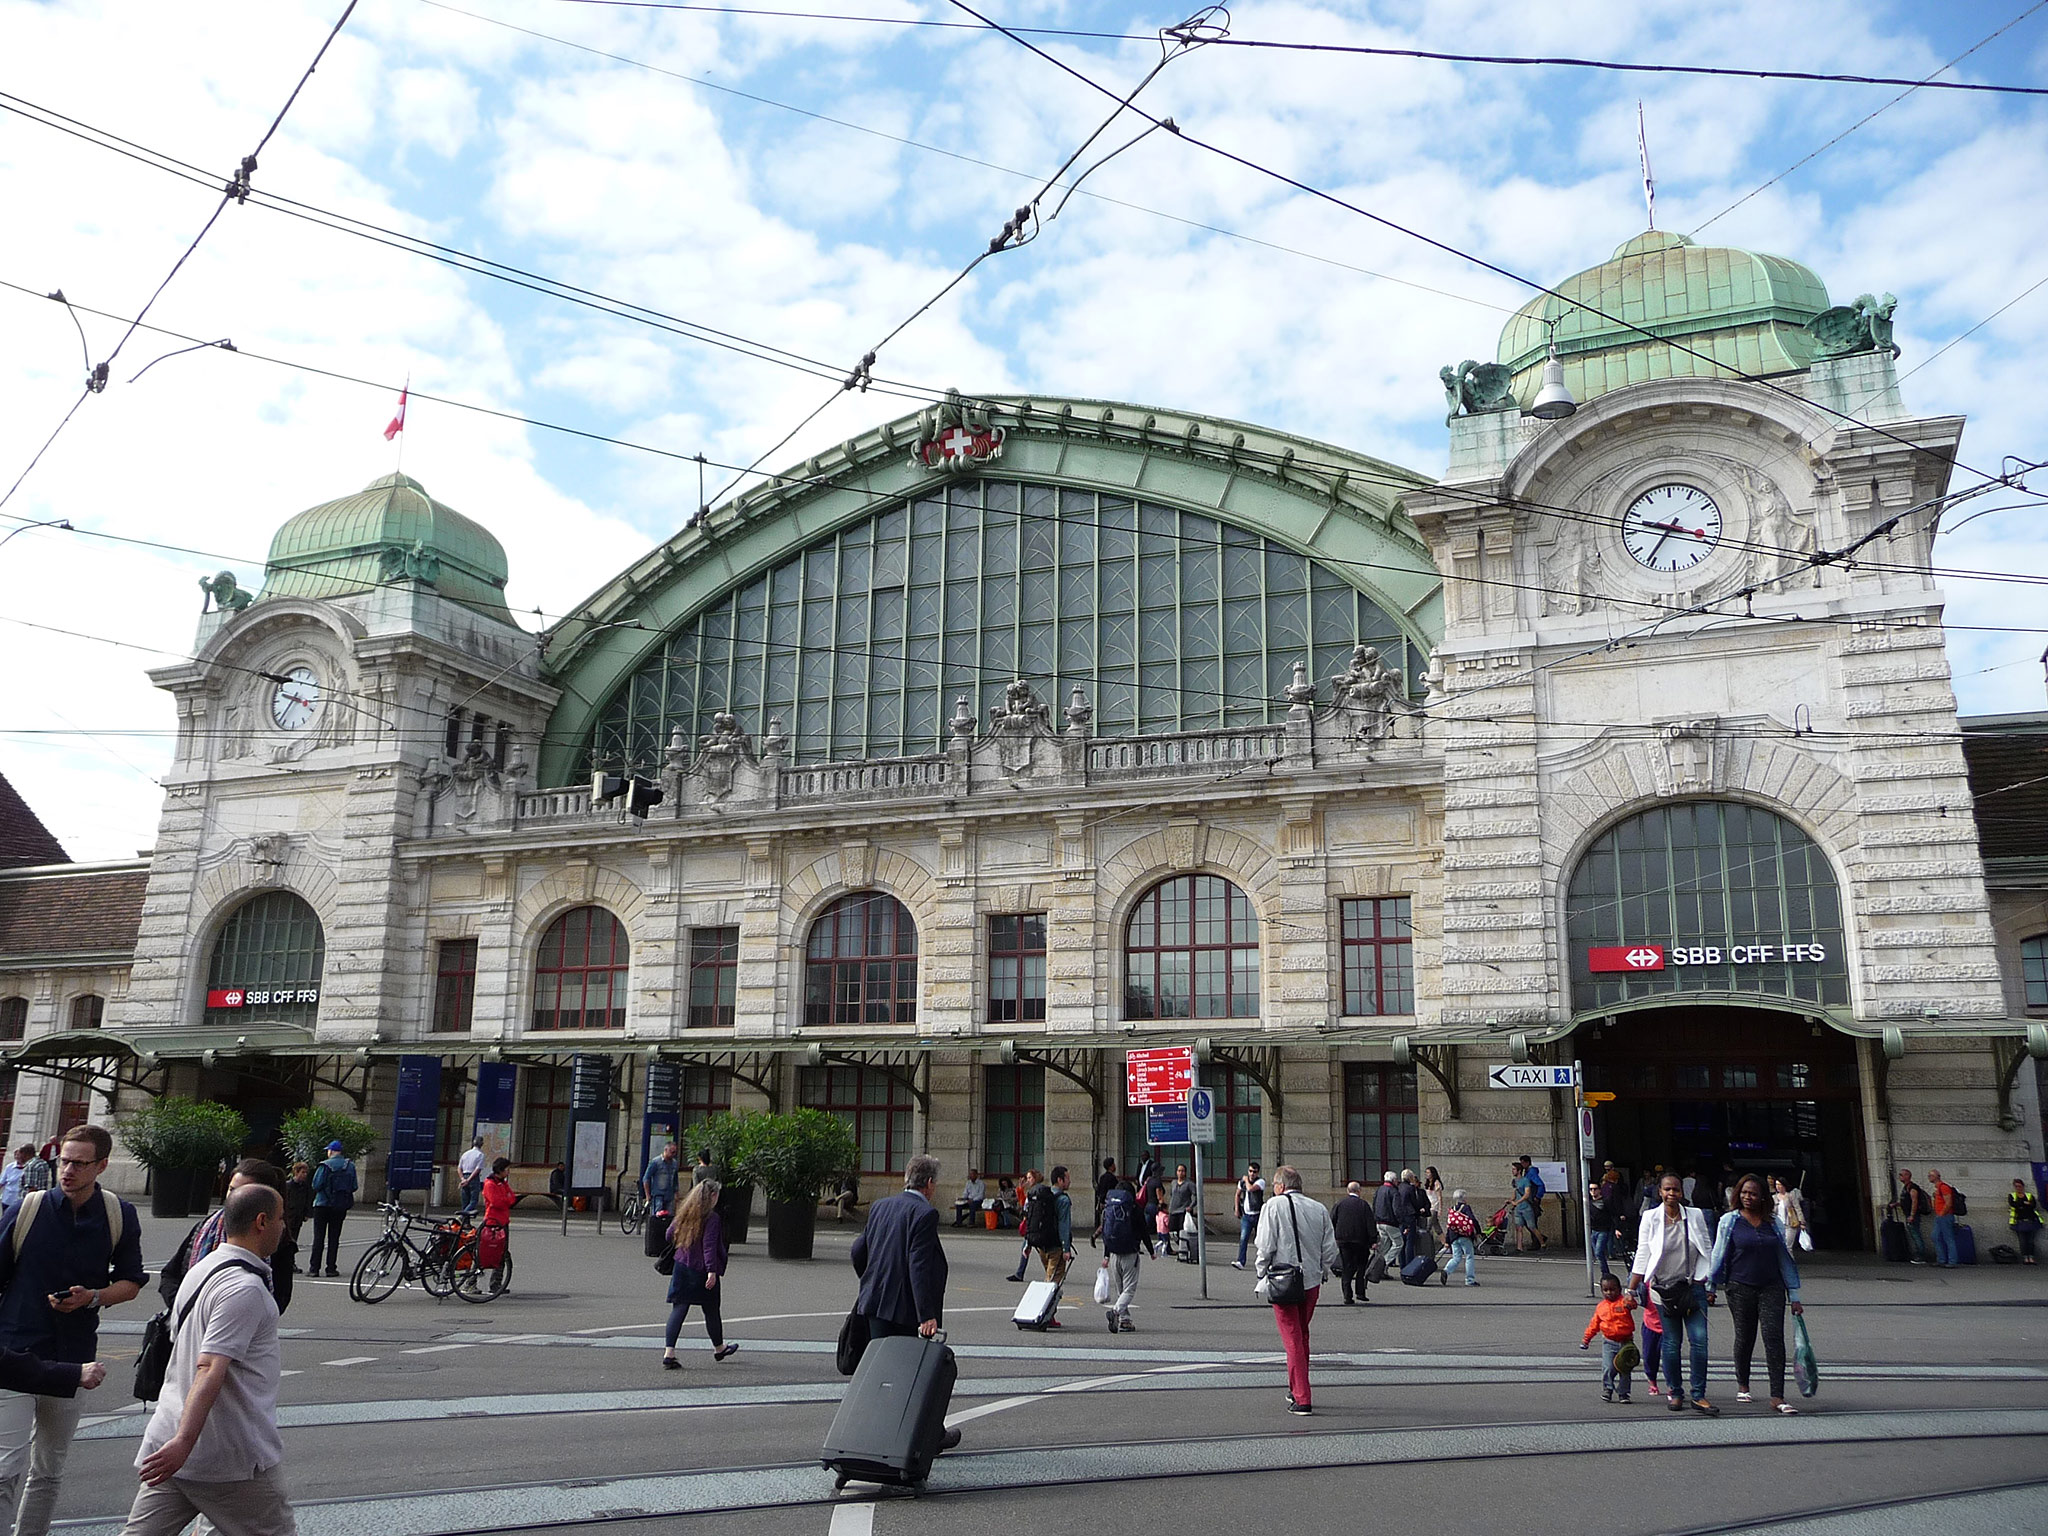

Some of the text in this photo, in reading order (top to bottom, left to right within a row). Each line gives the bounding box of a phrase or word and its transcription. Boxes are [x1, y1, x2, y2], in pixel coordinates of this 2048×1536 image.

[1672, 943, 1826, 965] SBB CFF FFS
[246, 989, 317, 1004] SBB CFF FFS
[1512, 1069, 1546, 1083] TAXI
